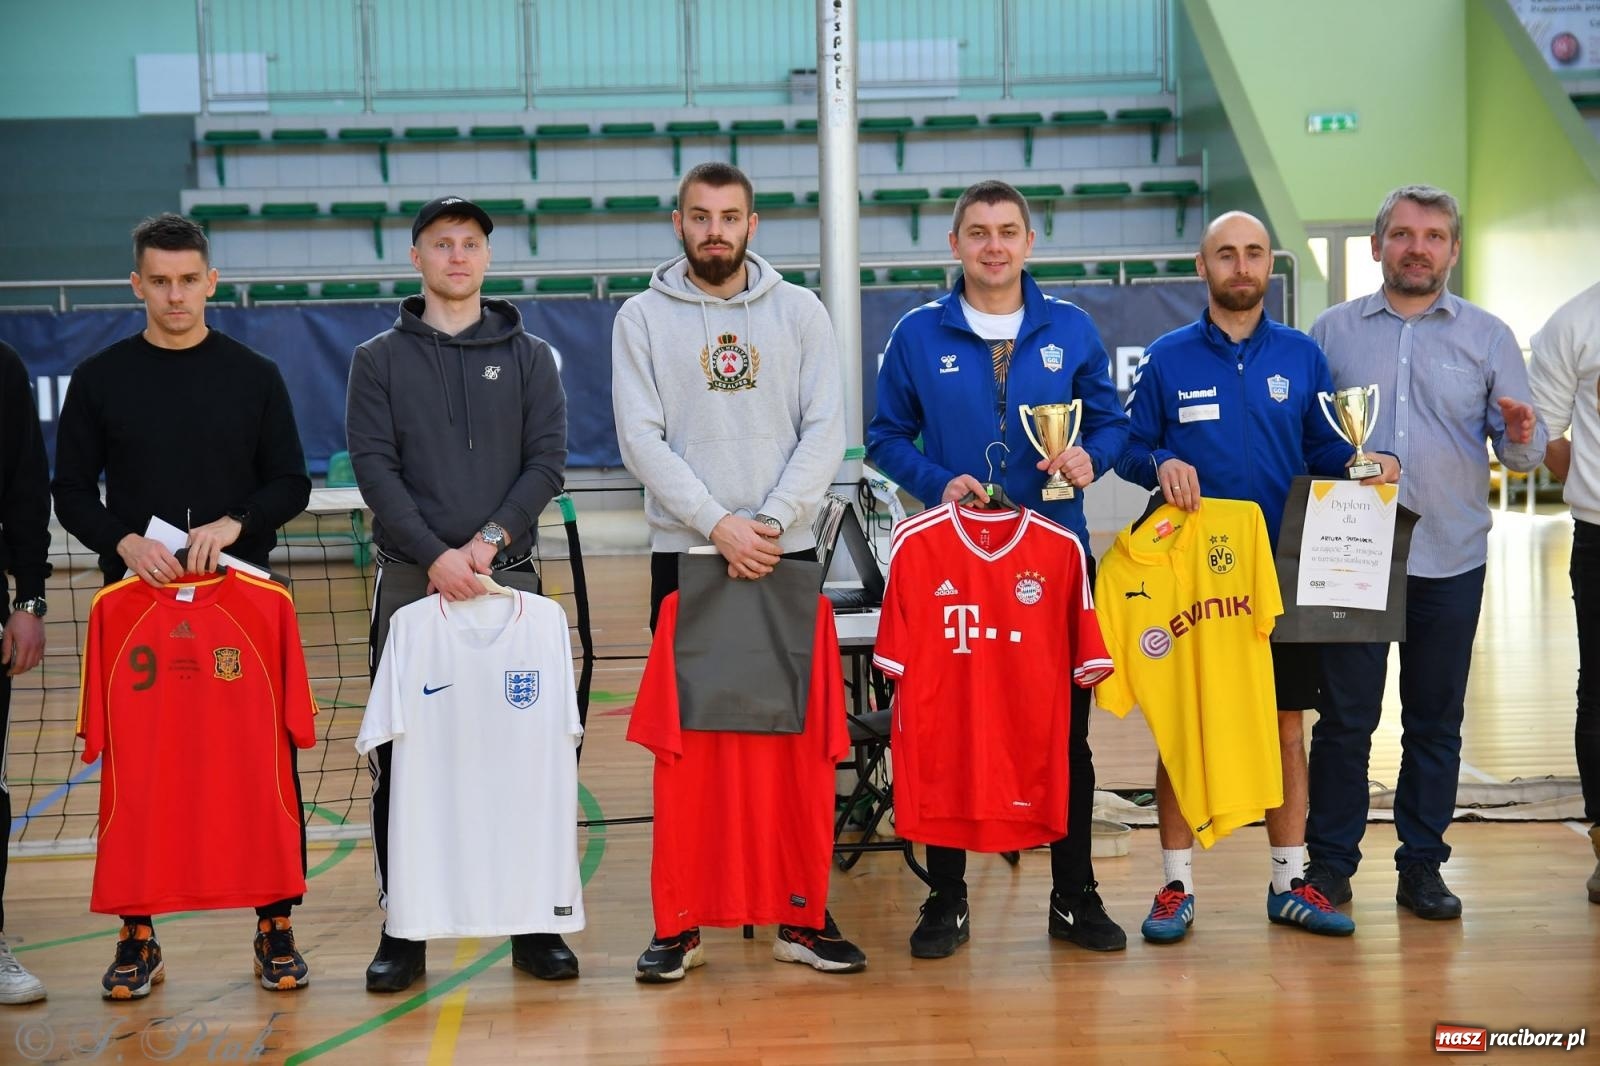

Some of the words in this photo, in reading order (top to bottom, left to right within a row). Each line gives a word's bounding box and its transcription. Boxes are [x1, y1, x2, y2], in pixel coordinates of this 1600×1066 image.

[1178, 386, 1217, 400] hummel
[1331, 499, 1371, 512] Dyplom
[1342, 514, 1357, 524] dla
[1210, 548, 1233, 566] BVB
[934, 589, 958, 597] adidas
[129, 645, 157, 692] 9
